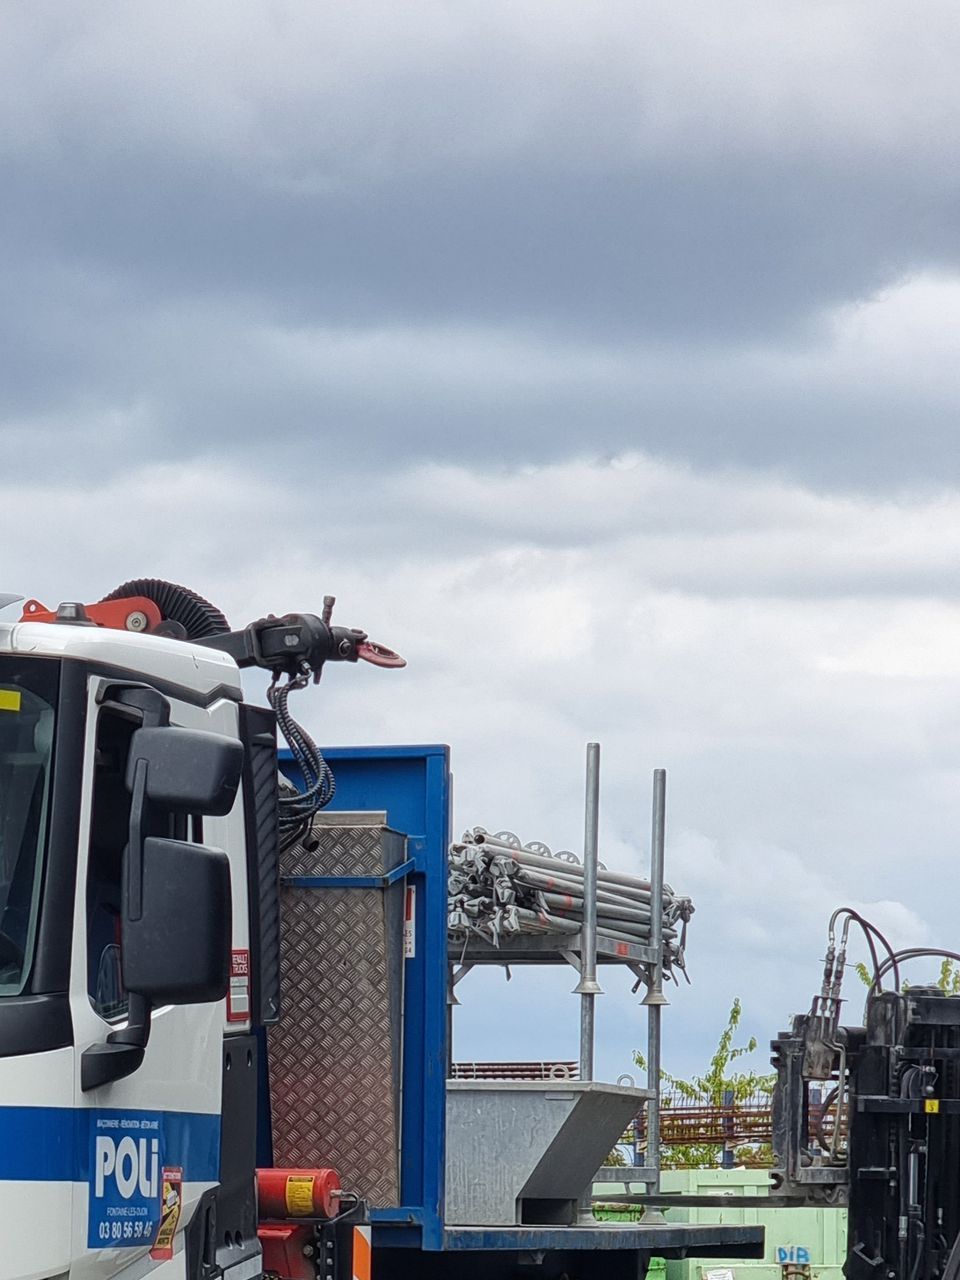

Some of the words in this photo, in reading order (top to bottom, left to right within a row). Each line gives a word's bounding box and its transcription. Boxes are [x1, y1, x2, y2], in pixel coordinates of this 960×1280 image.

[99, 1221, 110, 1239] 03
[111, 1221, 122, 1239] 80
[123, 1221, 133, 1238] 56
